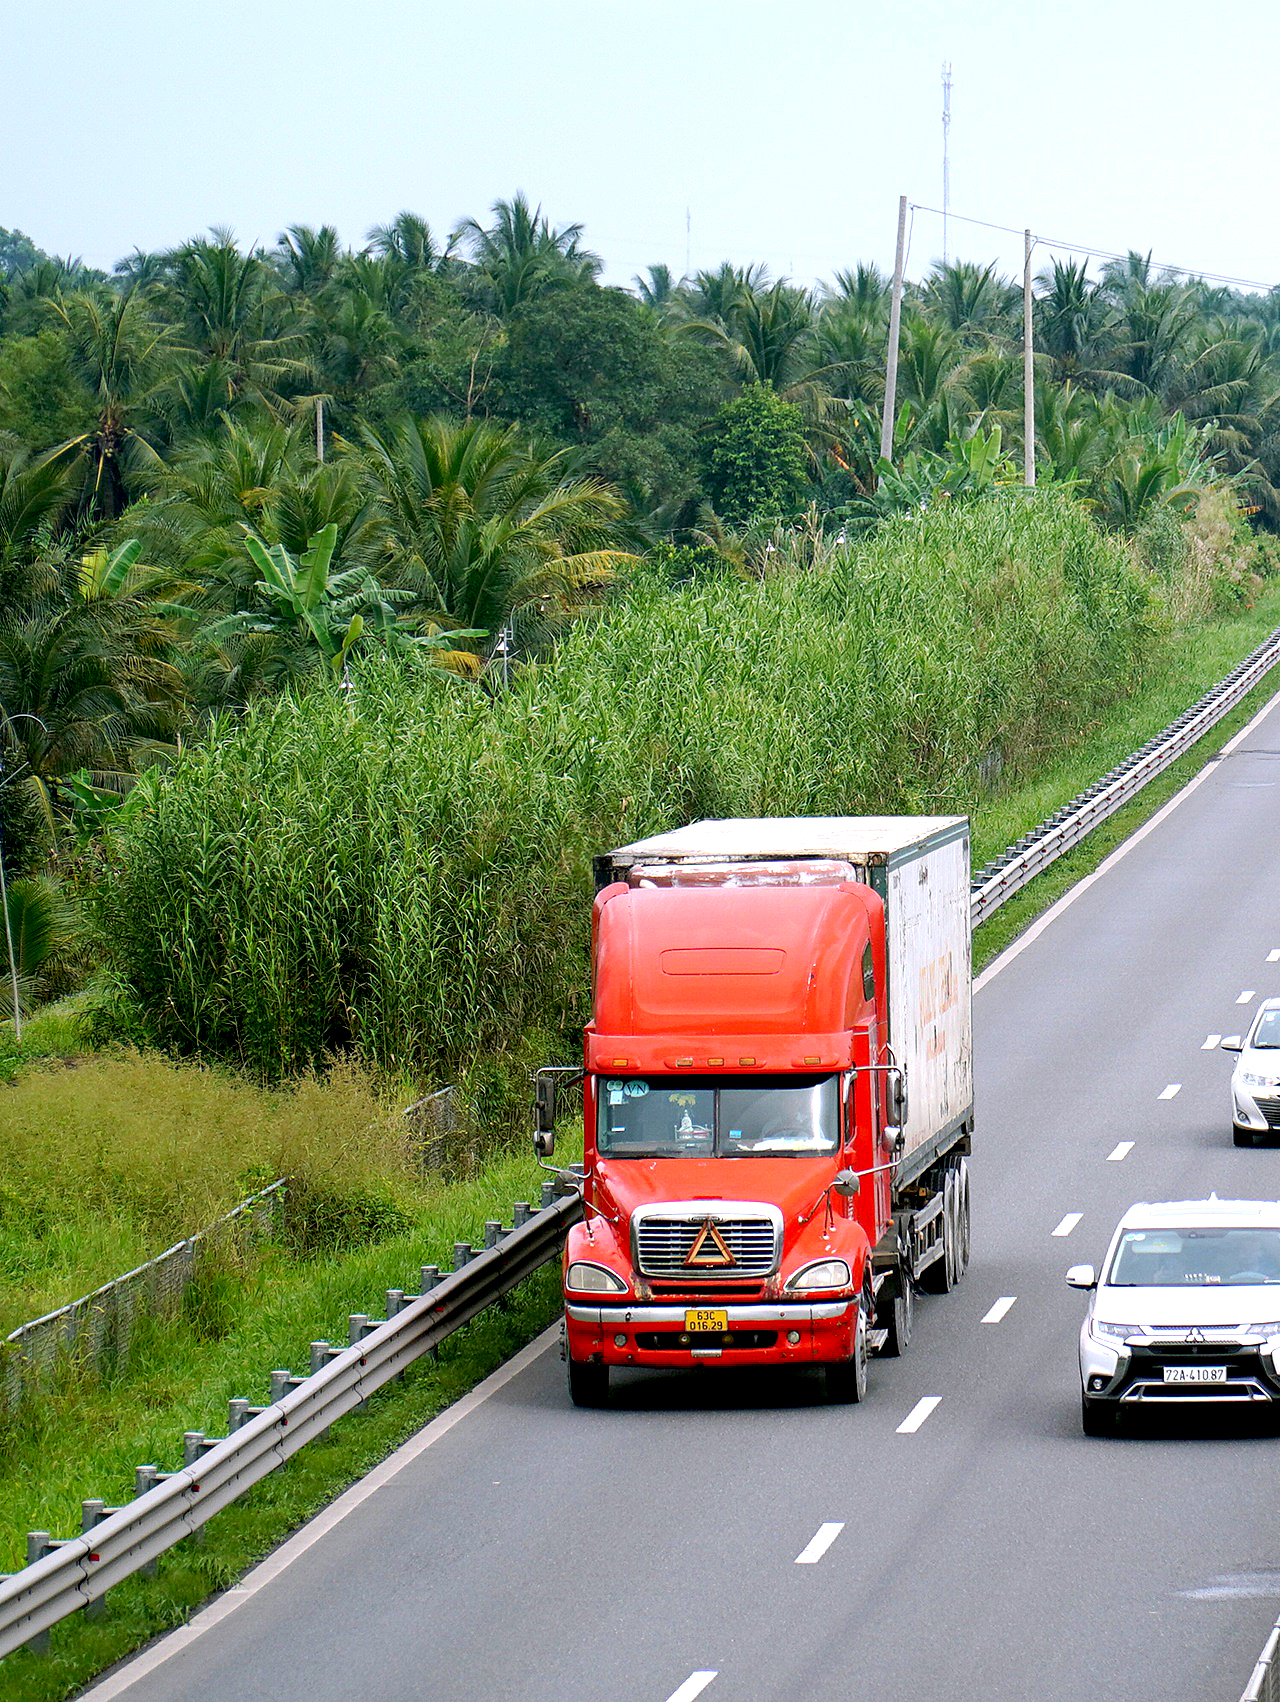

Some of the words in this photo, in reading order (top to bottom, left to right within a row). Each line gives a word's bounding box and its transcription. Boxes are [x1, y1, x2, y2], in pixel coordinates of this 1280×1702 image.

[626, 1084, 646, 1094] VN
[697, 1311, 715, 1320] 63C
[690, 1321, 723, 1330] 016.29
